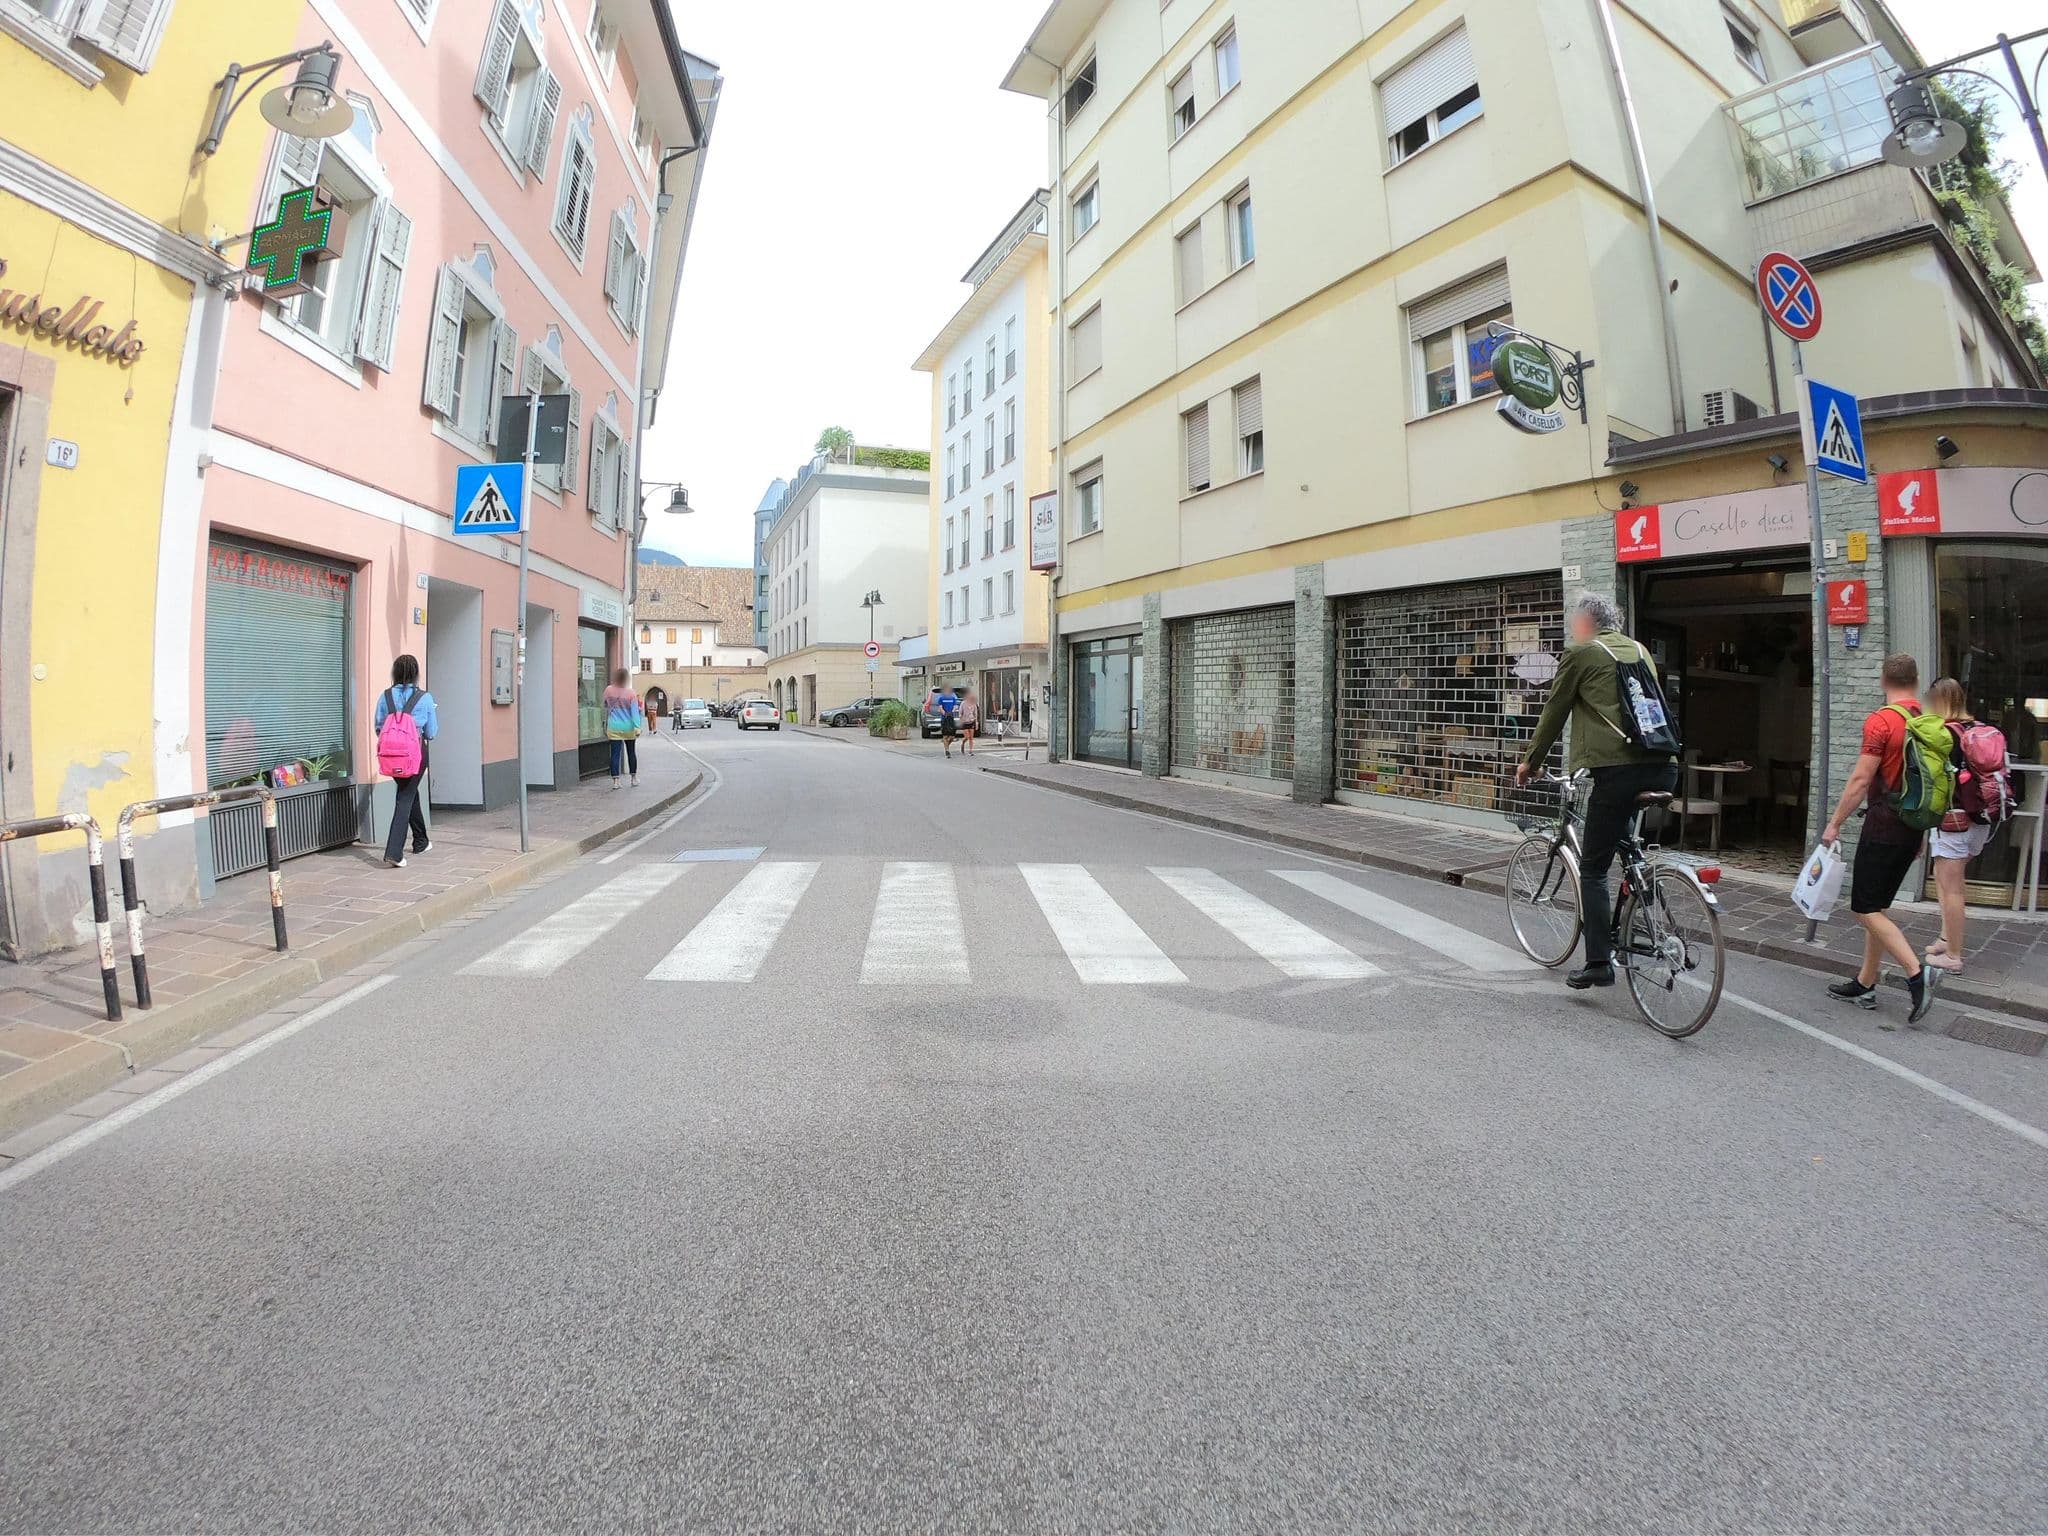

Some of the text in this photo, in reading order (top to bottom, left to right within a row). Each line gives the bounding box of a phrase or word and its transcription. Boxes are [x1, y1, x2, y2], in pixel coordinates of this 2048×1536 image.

[1513, 359, 1550, 386] FORST
[1528, 414, 1555, 429] CASELLO
[1674, 504, 1748, 541] Casello
[1882, 517, 1910, 526] Julius
